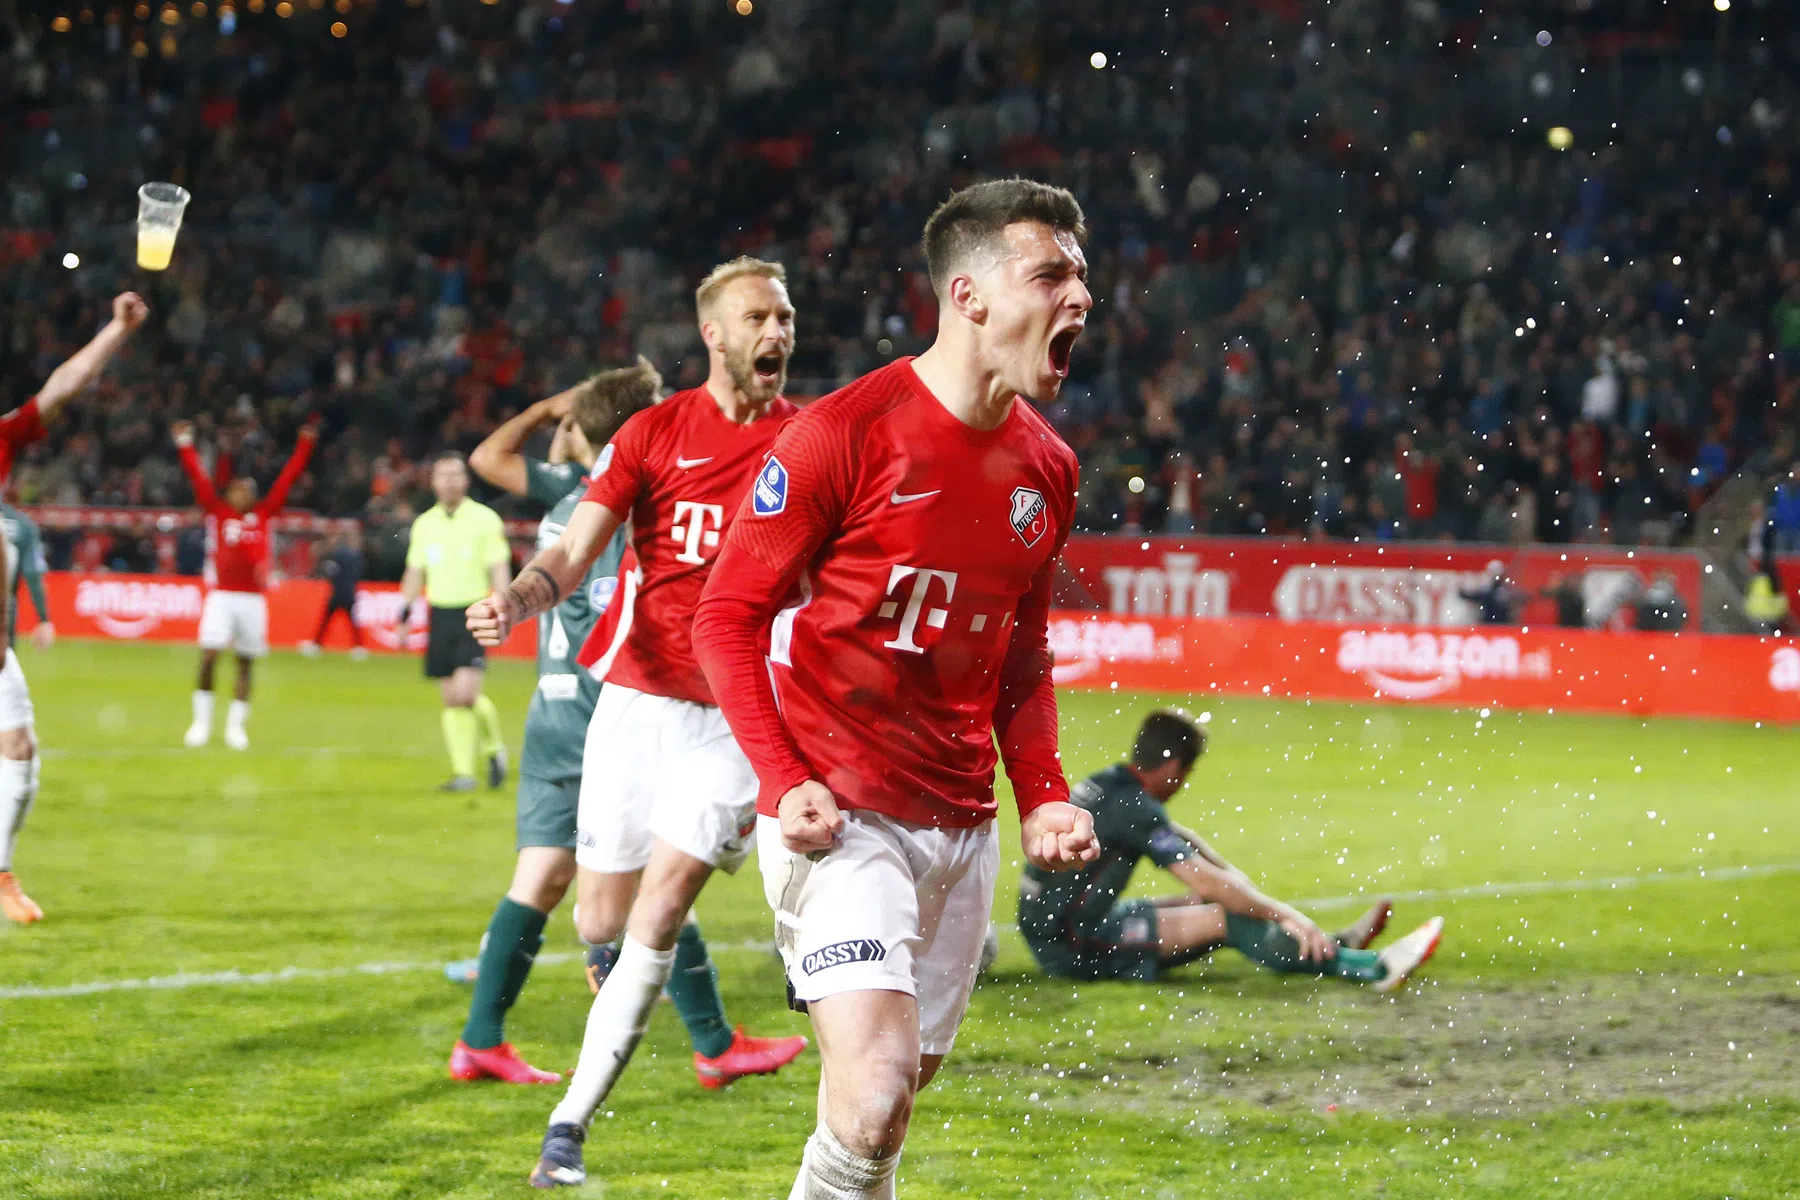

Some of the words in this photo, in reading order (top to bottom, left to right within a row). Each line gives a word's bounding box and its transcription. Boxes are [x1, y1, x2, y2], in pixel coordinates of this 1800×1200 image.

[1020, 495, 1027, 509] F
[1016, 496, 1044, 533] UTRECHT
[1031, 520, 1040, 534] C
[804, 941, 863, 974] DASSY
